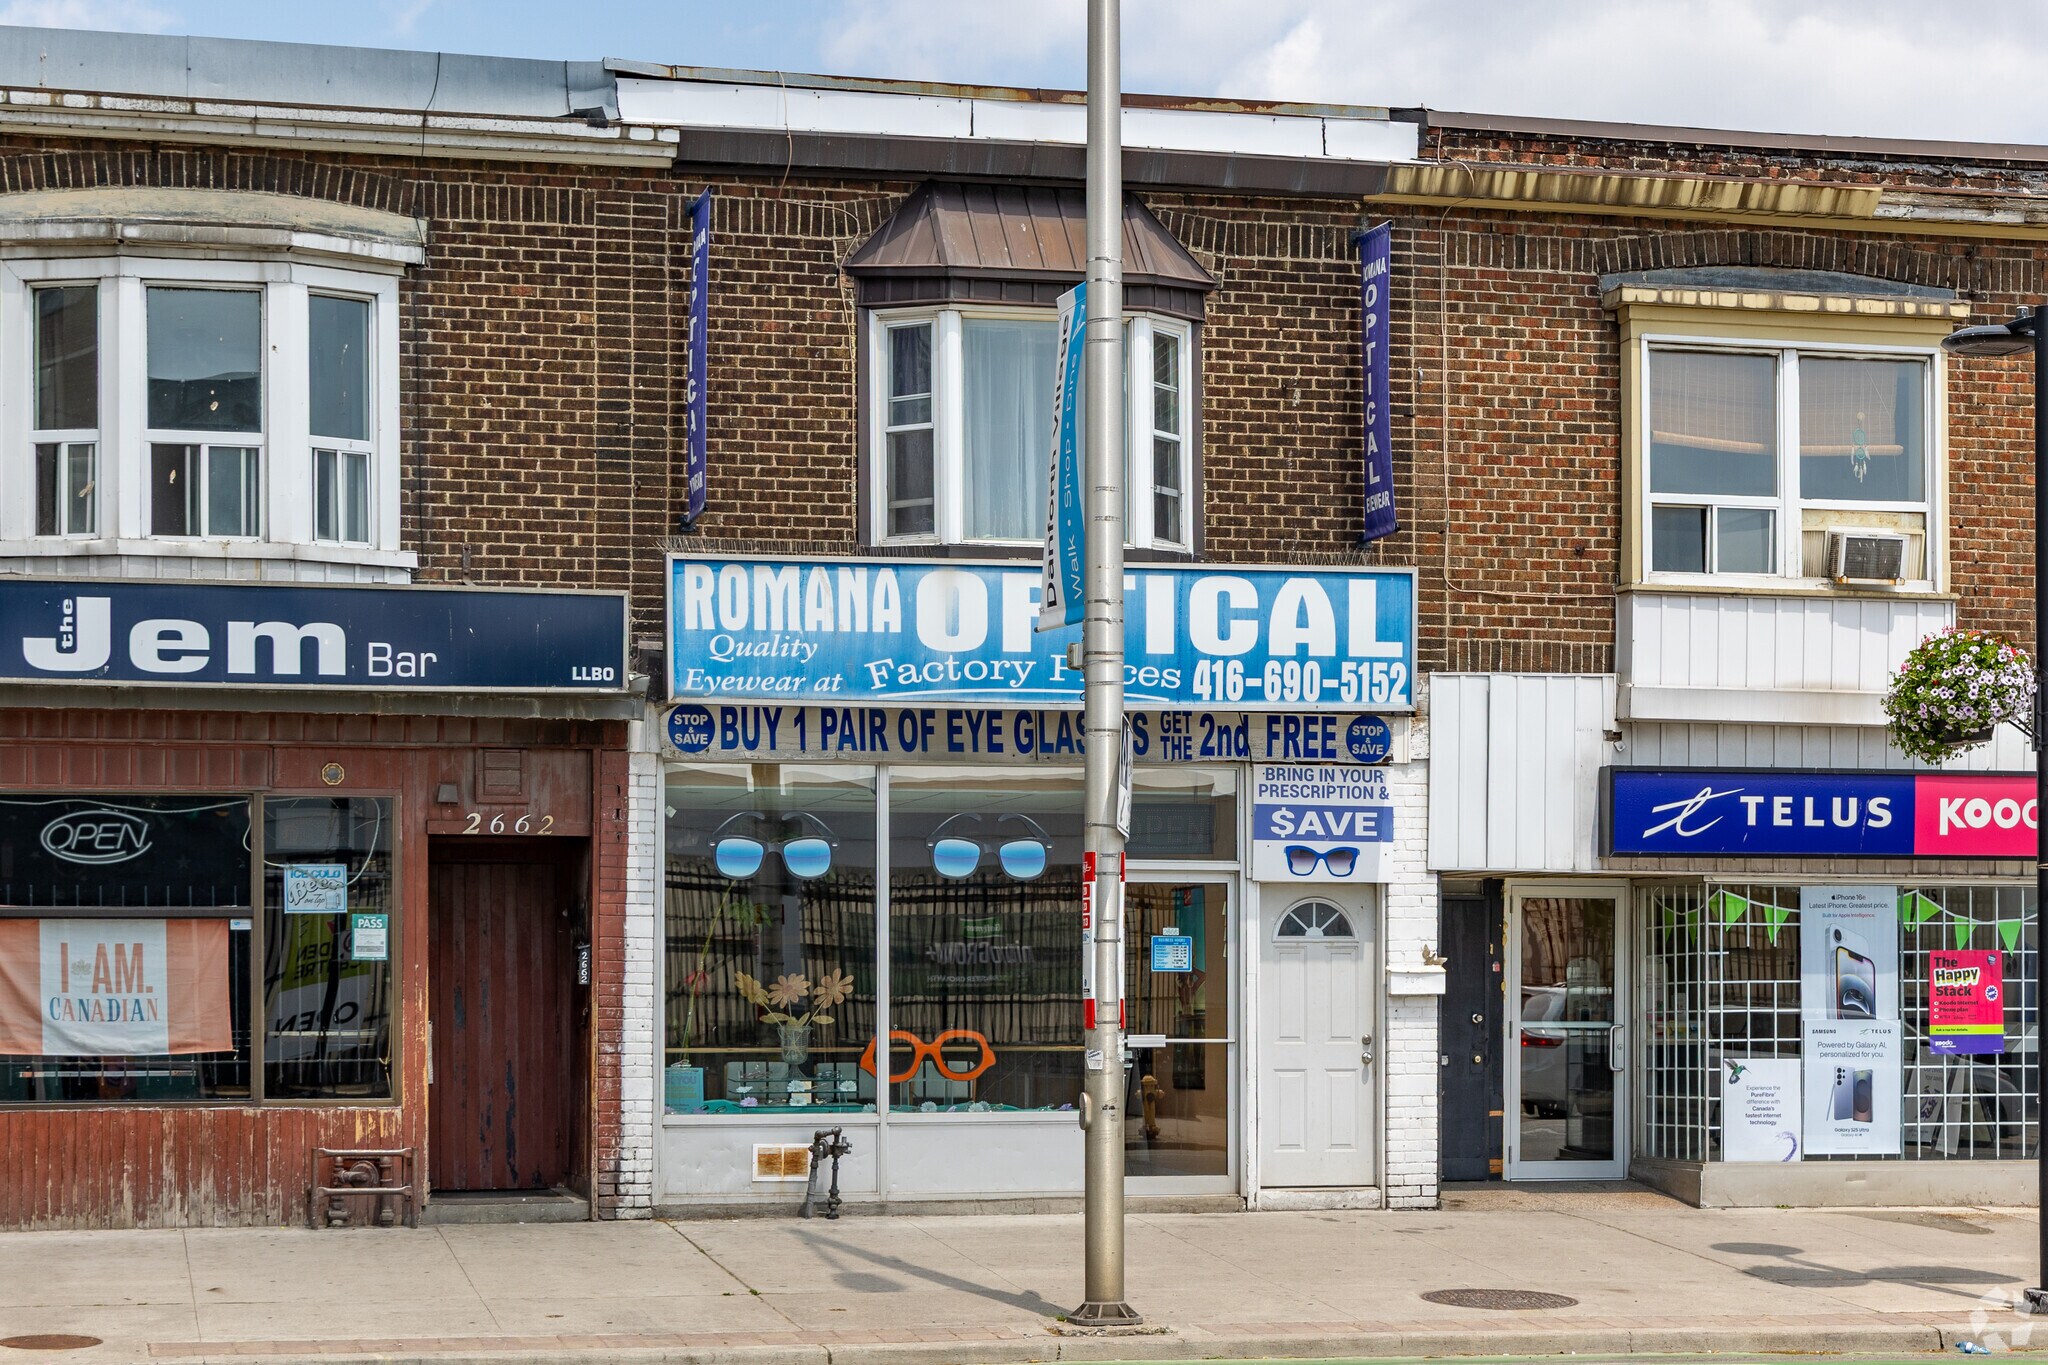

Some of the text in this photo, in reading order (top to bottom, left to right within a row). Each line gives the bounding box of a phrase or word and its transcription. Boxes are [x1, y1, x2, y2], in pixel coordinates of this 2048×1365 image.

[1365, 283, 1381, 485] OPTICAL
[1064, 439, 1073, 508] Shop
[1067, 533, 1083, 600] Walk
[684, 564, 1404, 658] ROMANA OPICAL
[23, 596, 438, 678] the Jem Bar
[708, 633, 819, 664] Quality
[571, 666, 616, 682] LLBO
[686, 668, 843, 696] Eyewear at
[864, 654, 1037, 690] Factory
[1192, 659, 1408, 704] 416-690-5152
[674, 713, 709, 726] STOP
[688, 726, 694, 734] &
[720, 706, 783, 751] BUY
[793, 707, 806, 752] 1
[821, 707, 889, 752] PAIR
[897, 708, 936, 753] OF
[946, 709, 1004, 754] EYE
[1160, 711, 1193, 735] GET
[1351, 724, 1385, 737] STOP
[674, 733, 709, 745] SAVE
[1160, 735, 1193, 761] THE
[1199, 713, 1338, 759] 2nd FREE
[1365, 736, 1372, 744] &
[1351, 742, 1385, 756] SAVE
[1265, 767, 1385, 784] BRING IN YOUR
[1258, 784, 1390, 800] PRESCRIPTION &
[462, 812, 555, 835] 2662
[1270, 806, 1378, 838] $AVE
[1739, 795, 1893, 829] TELUS
[46, 822, 151, 850] OPEN
[310, 869, 341, 879] COLD
[357, 918, 383, 928] PASS
[60, 942, 153, 994] I AM.
[580, 951, 588, 983] 2662
[1933, 956, 1958, 968] The
[1935, 968, 1979, 984] Happy
[1935, 986, 1972, 997] Stack
[49, 997, 160, 1022] CANADIAN
[1817, 1041, 1846, 1049] Powered
[1846, 1041, 1854, 1049] by
[1855, 1041, 1878, 1050] Galaxy
[1819, 1051, 1860, 1059] personalized
